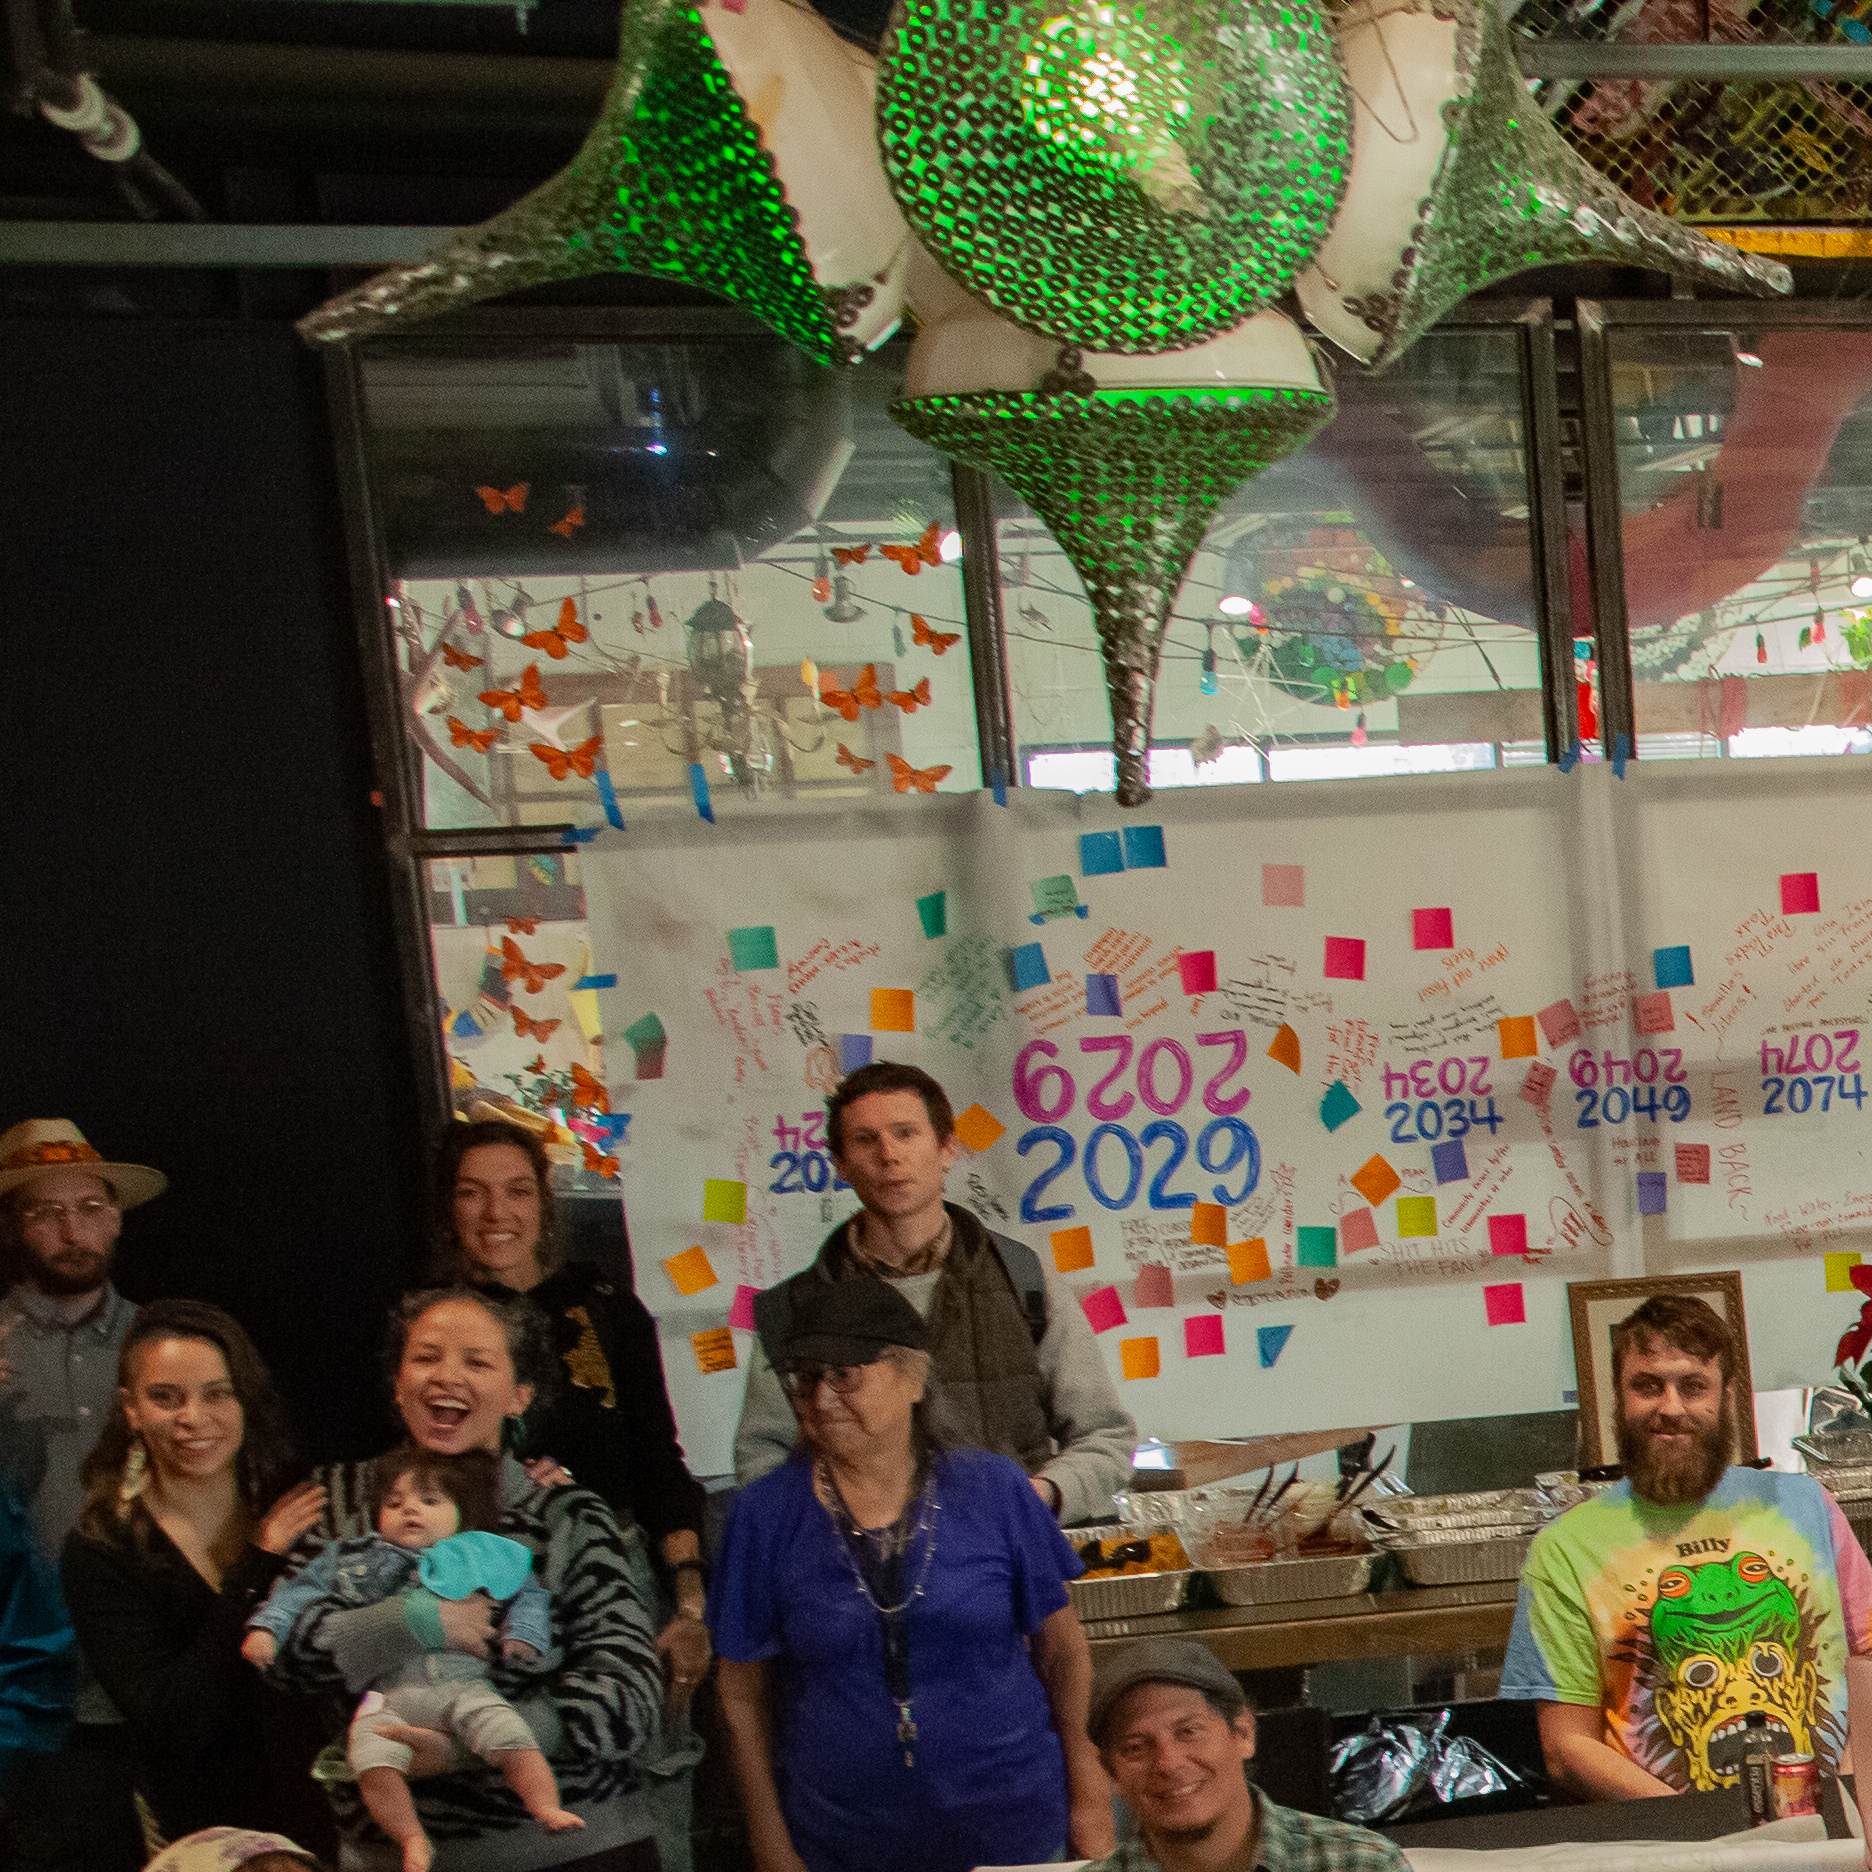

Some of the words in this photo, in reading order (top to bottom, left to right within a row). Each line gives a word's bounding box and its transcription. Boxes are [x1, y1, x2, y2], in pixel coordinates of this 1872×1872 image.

[1568, 1047, 1688, 1090] 2049
[1759, 1029, 1861, 1077] 2074
[1011, 1029, 1252, 1125] 2029
[1379, 1055, 1494, 1101] 2034
[1709, 1069, 1743, 1130] LAND
[1761, 1072, 1869, 1115] 2074
[1384, 1096, 1505, 1144] 2034
[1575, 1084, 1692, 1129] 2049
[1015, 1116, 1262, 1224] 2029
[1675, 1537, 1732, 1559] Billy
